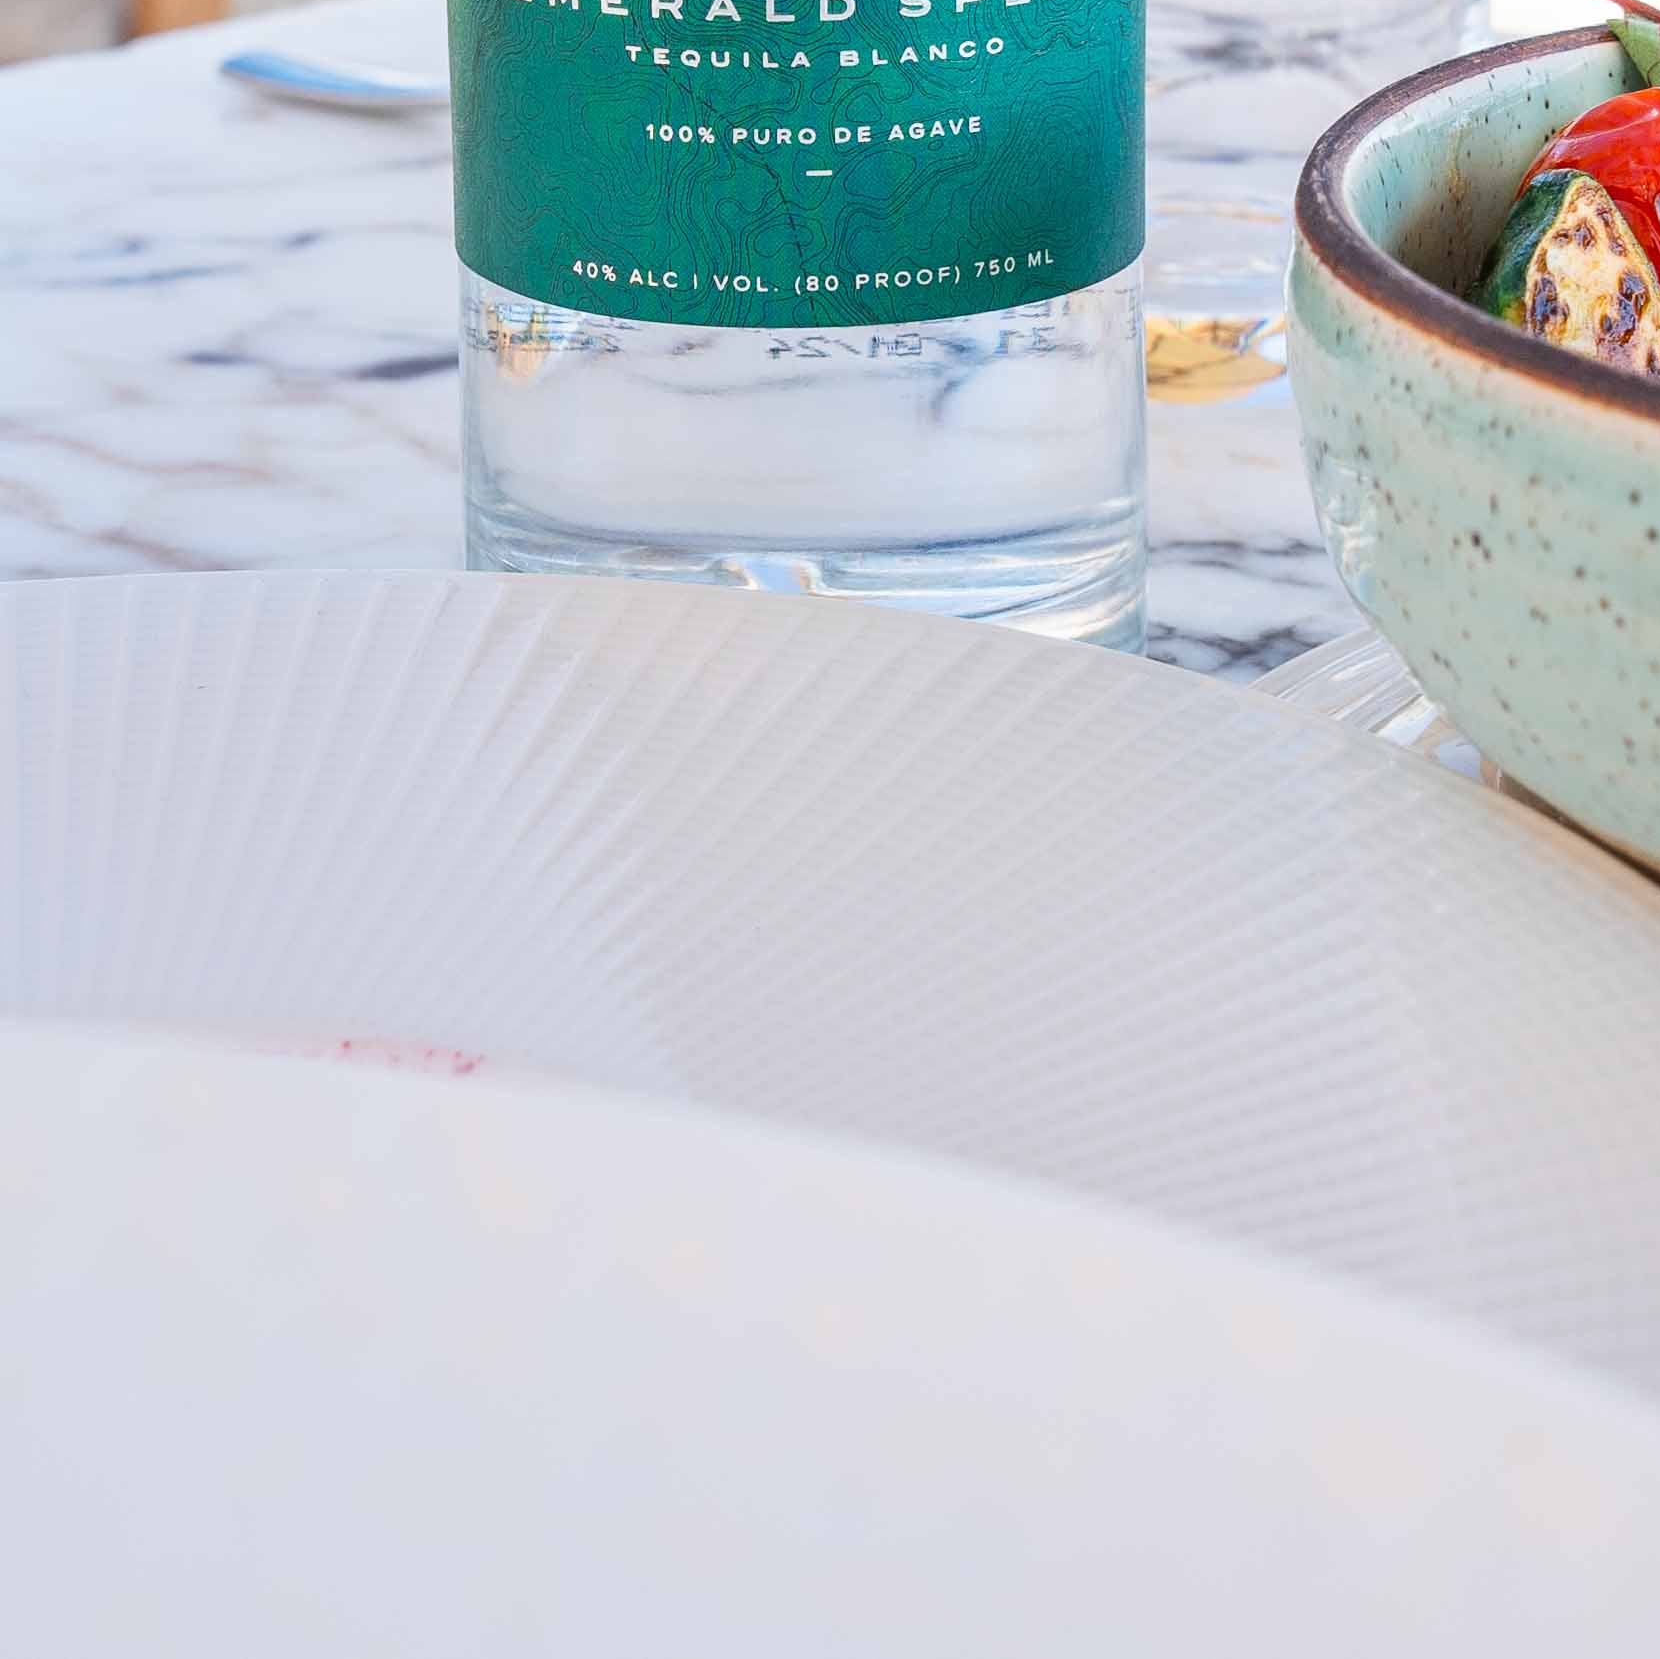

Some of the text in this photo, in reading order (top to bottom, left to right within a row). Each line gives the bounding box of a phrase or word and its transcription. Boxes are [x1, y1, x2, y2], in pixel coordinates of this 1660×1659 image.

[625, 37, 1005, 69] TEQUILA BLANCO
[646, 116, 982, 146] 100% PURO DE AGAVE
[572, 260, 617, 282] 40%
[629, 268, 678, 289] ALC
[713, 274, 779, 293] VOL.
[793, 275, 840, 295] (80
[855, 266, 962, 291] PROOF)
[974, 256, 1017, 278] 750
[1027, 248, 1055, 268] ML
